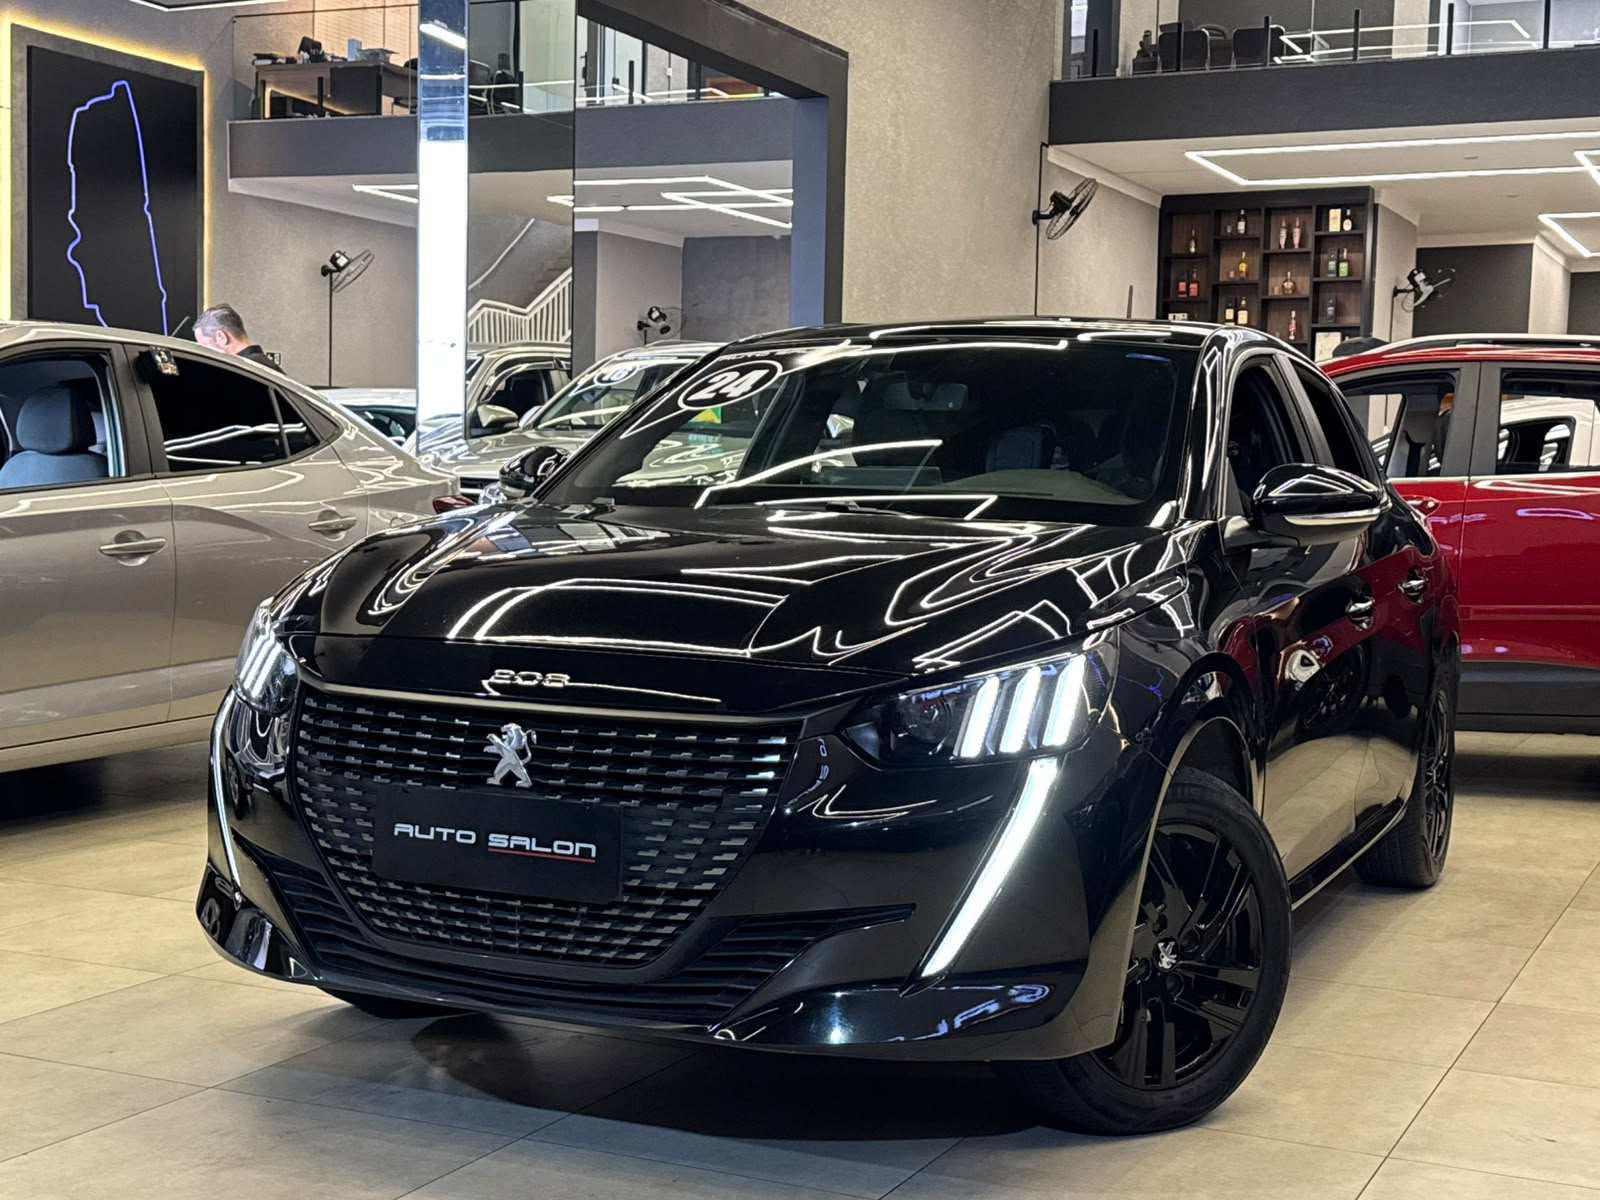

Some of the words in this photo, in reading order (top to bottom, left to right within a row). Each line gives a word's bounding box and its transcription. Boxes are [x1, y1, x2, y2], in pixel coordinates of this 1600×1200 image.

[686, 370, 770, 400] 24
[489, 668, 570, 687] 208
[393, 822, 477, 844] AUTO
[487, 833, 597, 858] SALON
